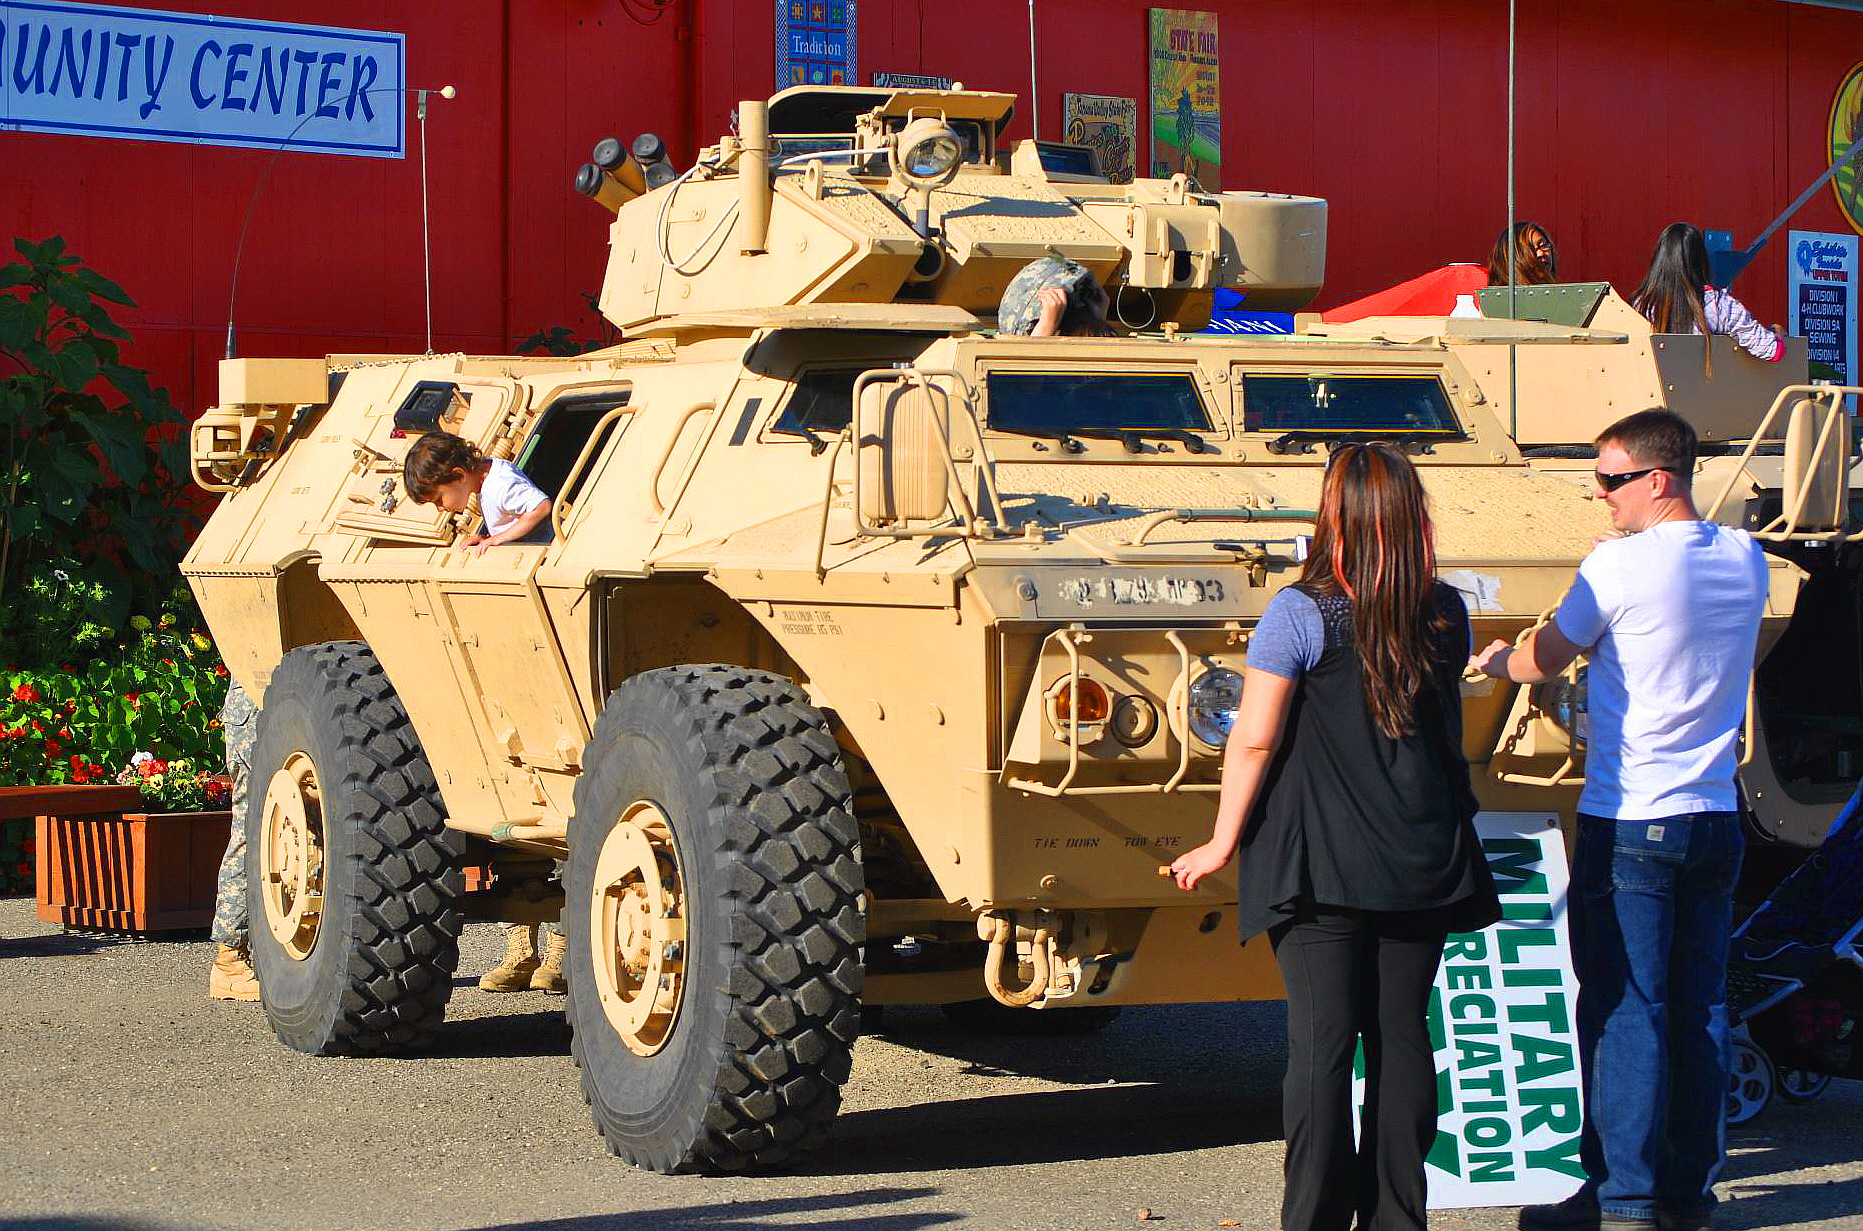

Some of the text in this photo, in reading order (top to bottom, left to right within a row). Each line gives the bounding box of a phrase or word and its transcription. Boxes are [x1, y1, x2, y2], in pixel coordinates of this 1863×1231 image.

[792, 34, 842, 56] Tradition
[0, 18, 379, 123] UNITY CENTER
[1809, 289, 1833, 303] DIVISION
[1804, 317, 1831, 331] DIVISION
[1809, 331, 1837, 345] SEWING
[1807, 348, 1832, 361] DIVISION
[1033, 836, 1181, 849] TIE DOWN TOW EYE
[1482, 838, 1589, 1181] MILITARY
